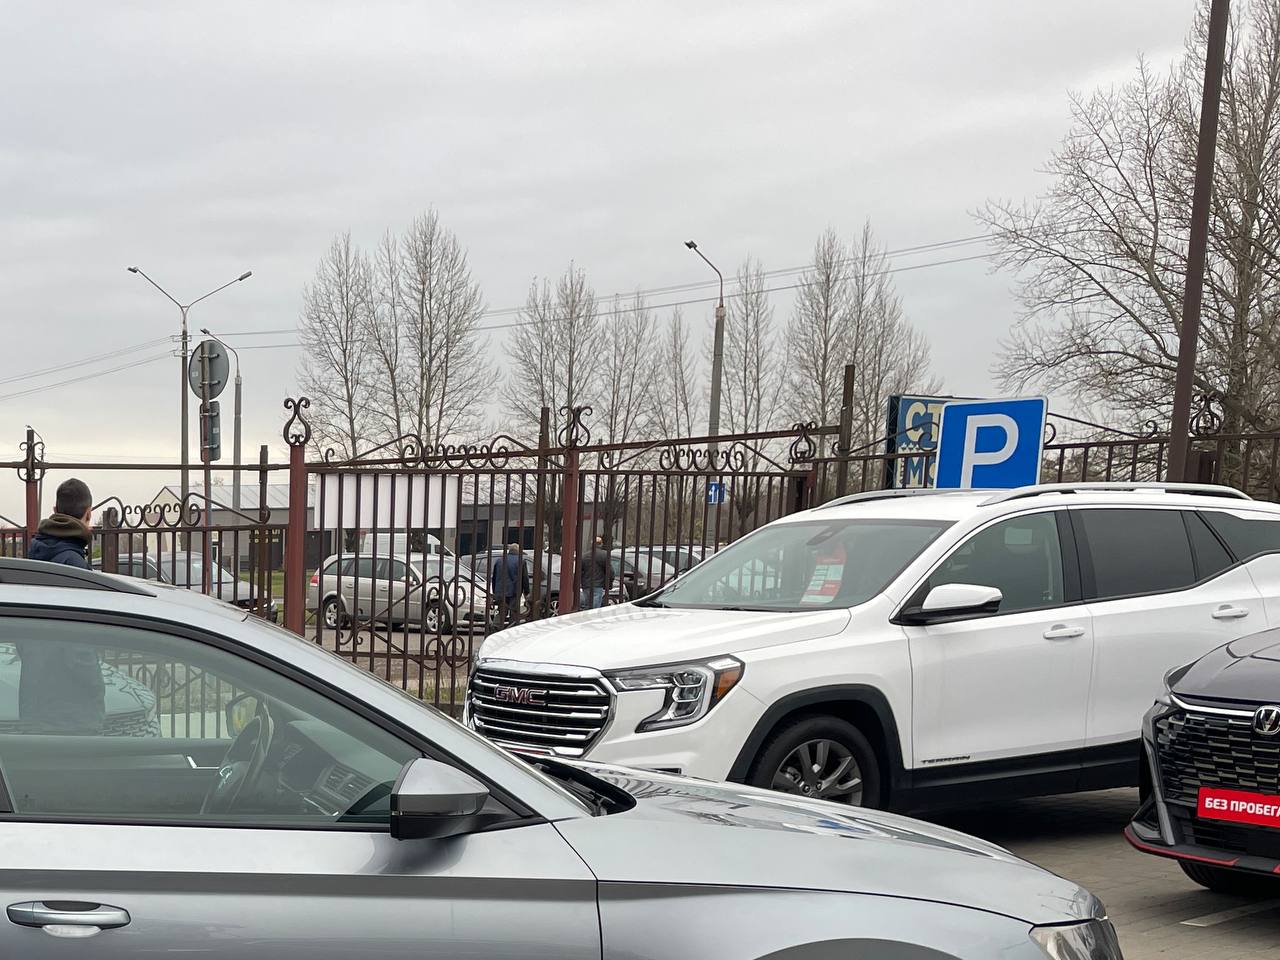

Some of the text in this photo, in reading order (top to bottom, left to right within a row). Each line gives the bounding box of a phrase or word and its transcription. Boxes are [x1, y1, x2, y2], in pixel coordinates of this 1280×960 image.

[905, 401, 944, 443] СТ
[960, 413, 1019, 488] P
[494, 685, 547, 706] GMC
[1205, 797, 1228, 810] БЕЗ
